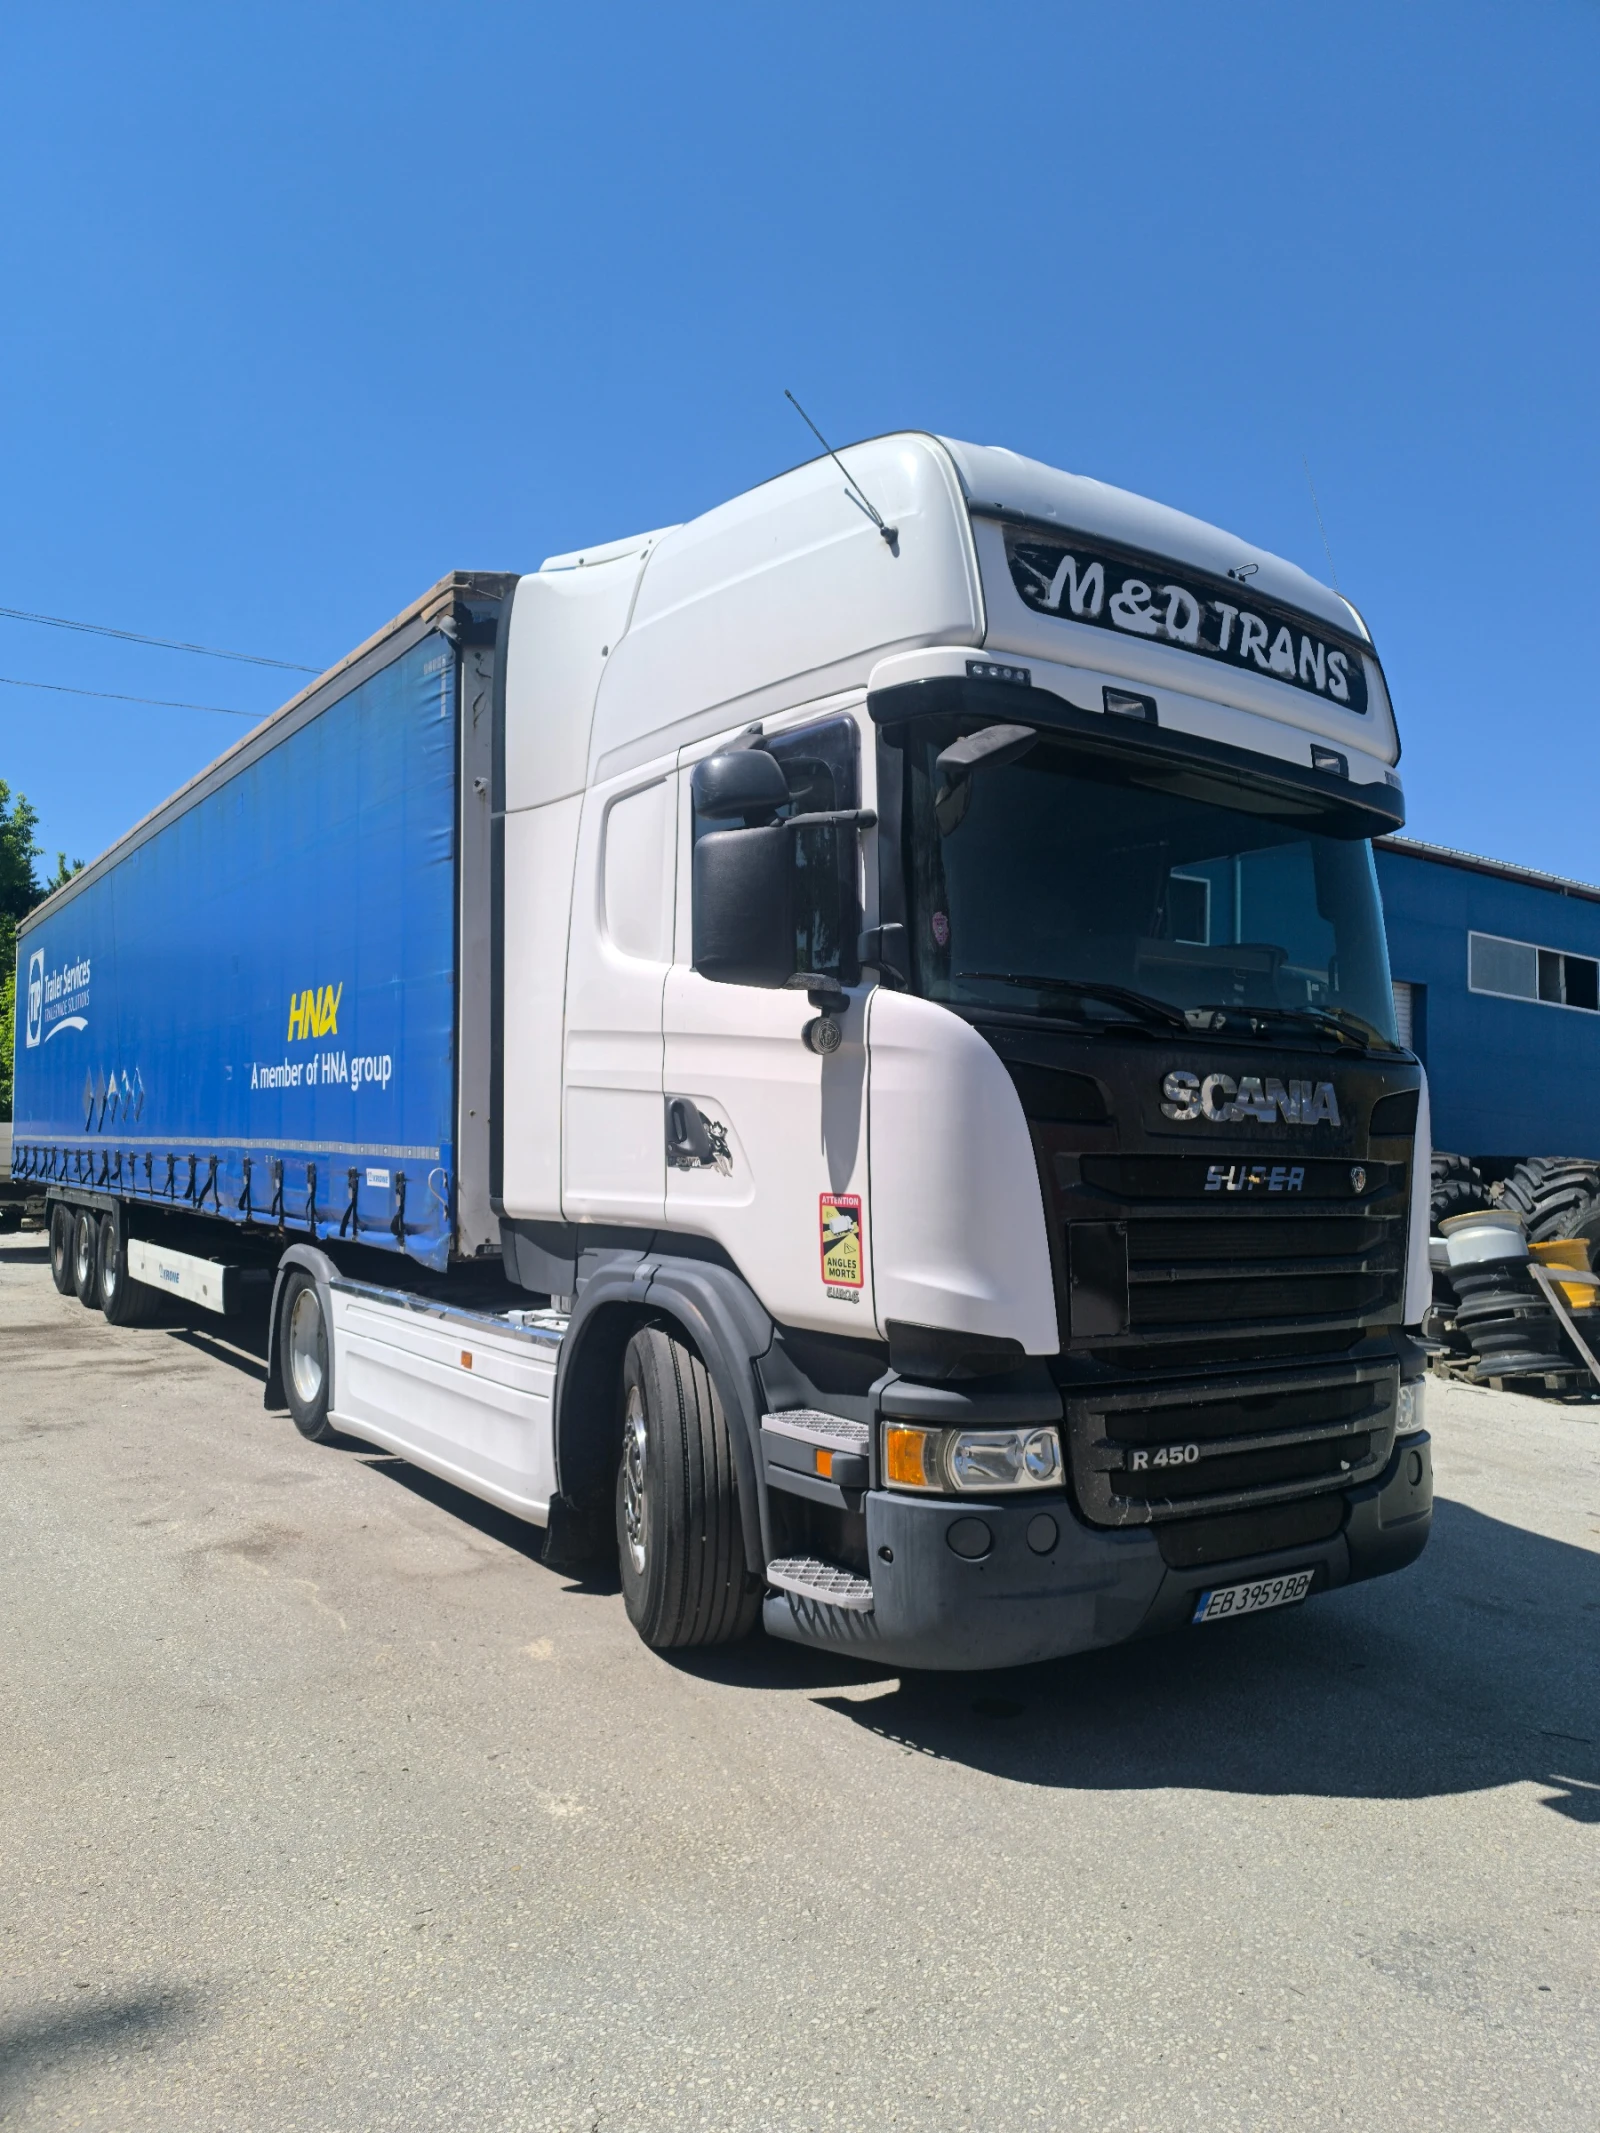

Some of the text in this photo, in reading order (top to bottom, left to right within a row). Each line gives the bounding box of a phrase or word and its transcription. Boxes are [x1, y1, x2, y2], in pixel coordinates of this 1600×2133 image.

[1214, 600, 1350, 701] TRANS
[44, 956, 90, 1004] Trailer Services
[30, 980, 40, 1022] TIP
[250, 1050, 392, 1092] A member of HNA group
[1160, 1070, 1342, 1127] SCANIA
[1203, 1165, 1306, 1191] SUPER
[821, 1195, 860, 1206] ATTENTION
[827, 1257, 857, 1269] ANGLES
[828, 1267, 856, 1279] MORTS
[1132, 1444, 1200, 1471] R 450
